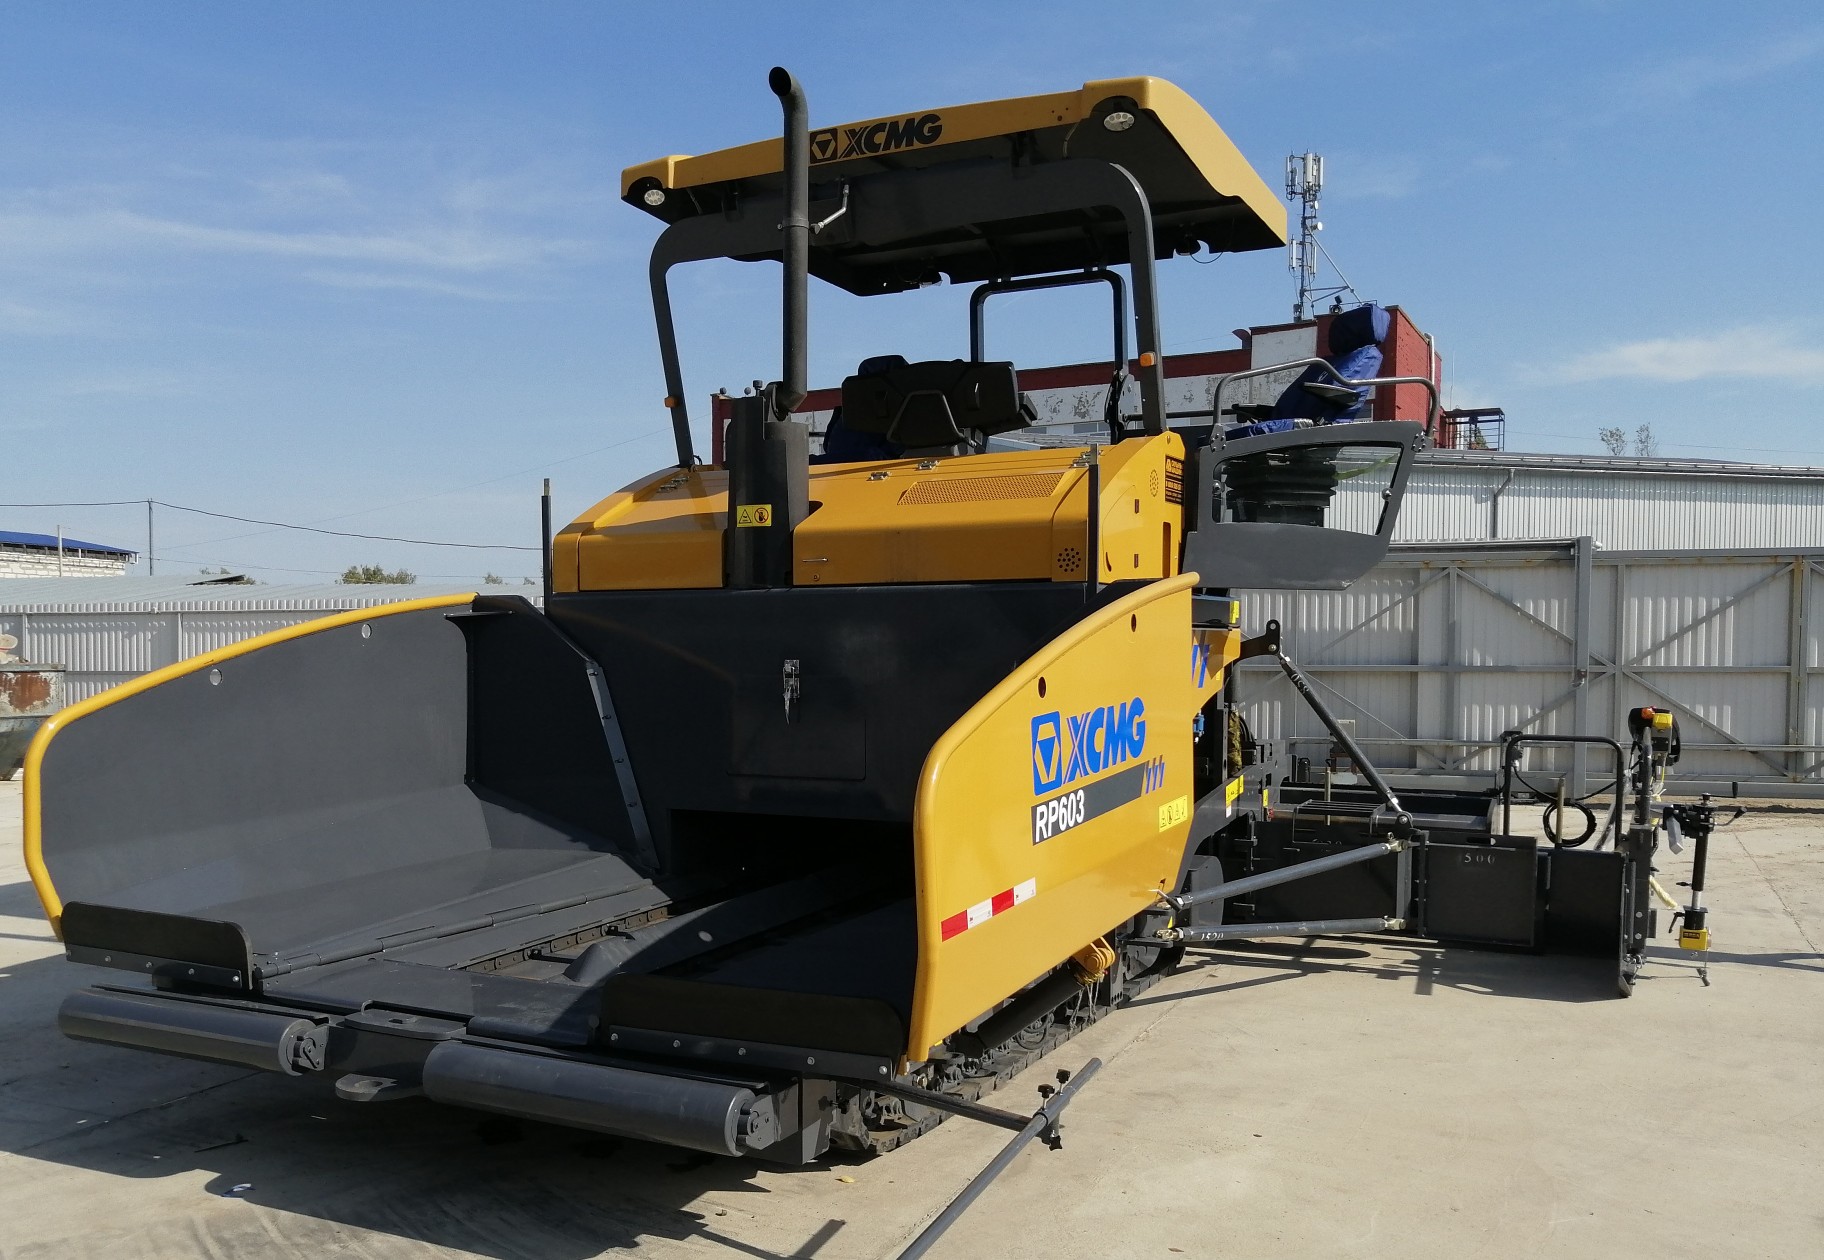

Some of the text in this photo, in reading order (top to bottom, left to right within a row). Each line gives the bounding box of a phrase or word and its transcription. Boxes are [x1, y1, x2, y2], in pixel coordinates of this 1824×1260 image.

[839, 113, 943, 159] XCMG
[1062, 697, 1146, 785] XCMG
[1035, 789, 1085, 843] RP603
